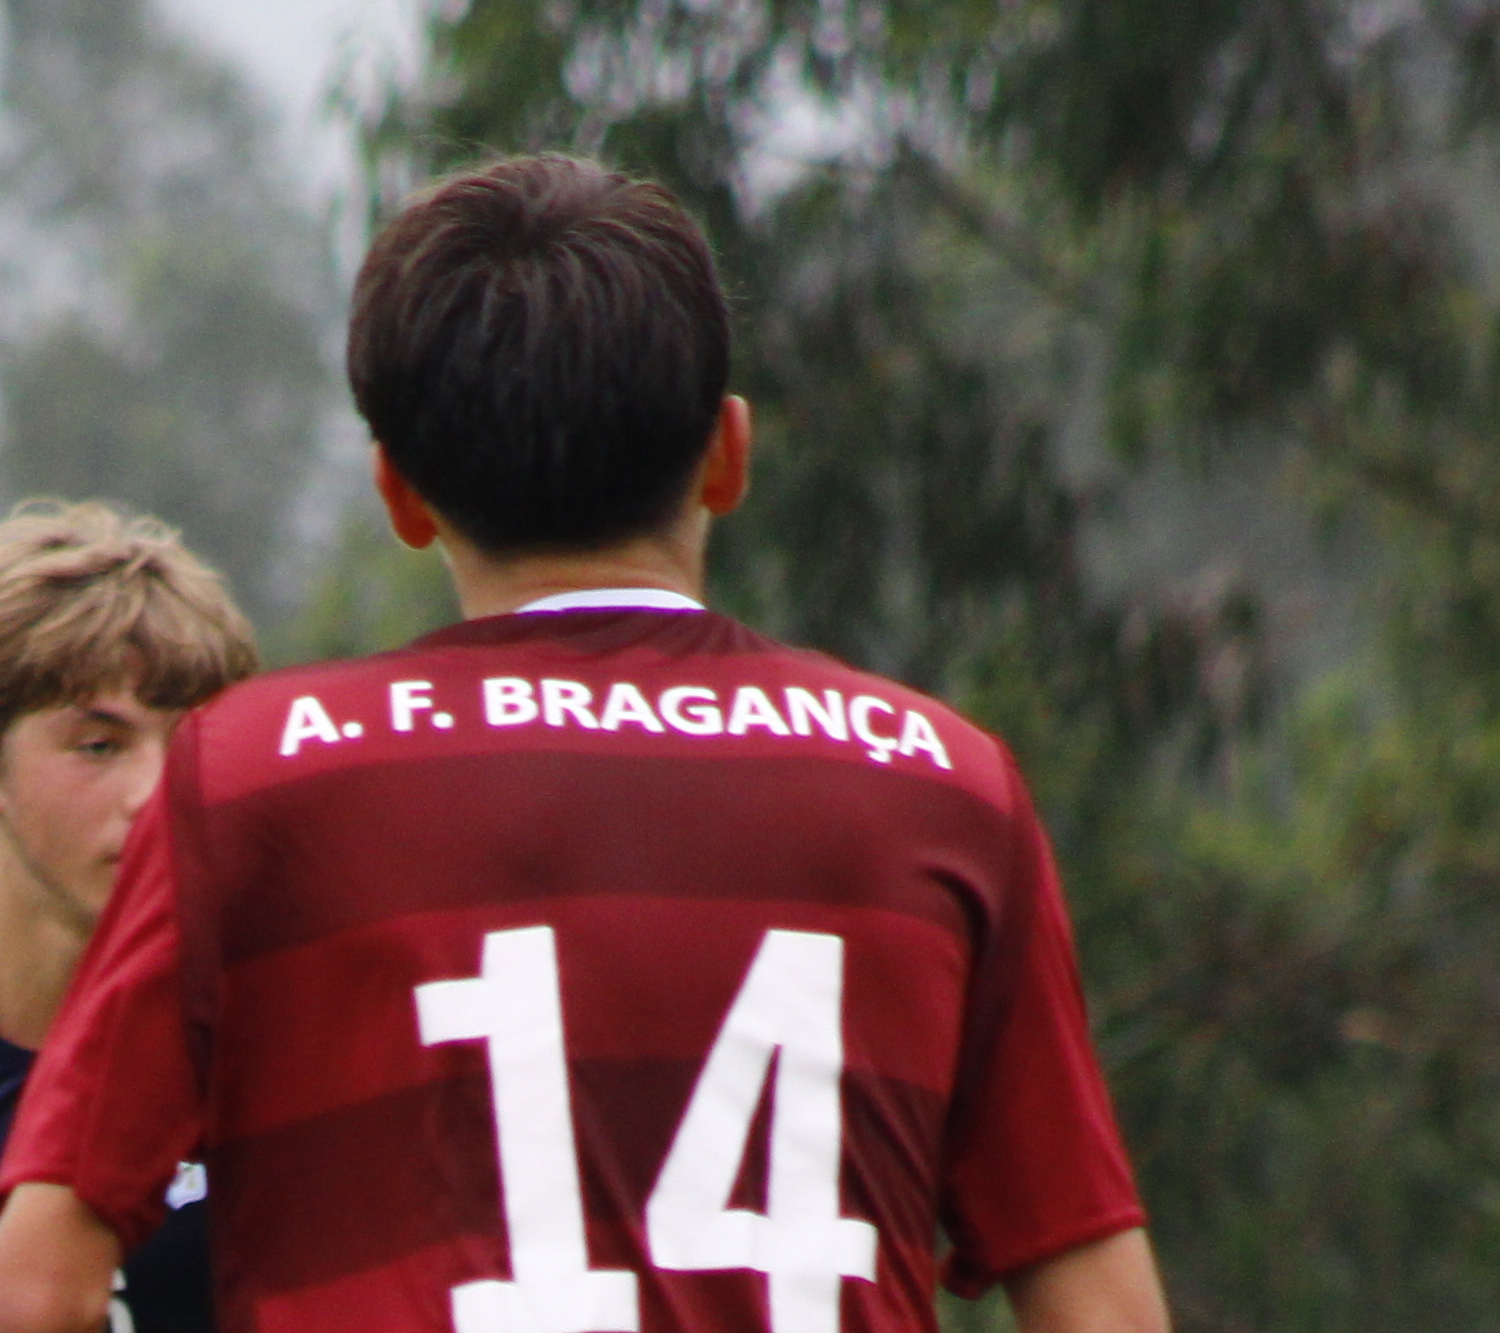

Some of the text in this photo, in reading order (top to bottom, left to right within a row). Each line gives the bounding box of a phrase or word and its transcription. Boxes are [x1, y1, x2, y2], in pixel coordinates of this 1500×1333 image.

[278, 675, 954, 771] A. F. BRAGANÇA
